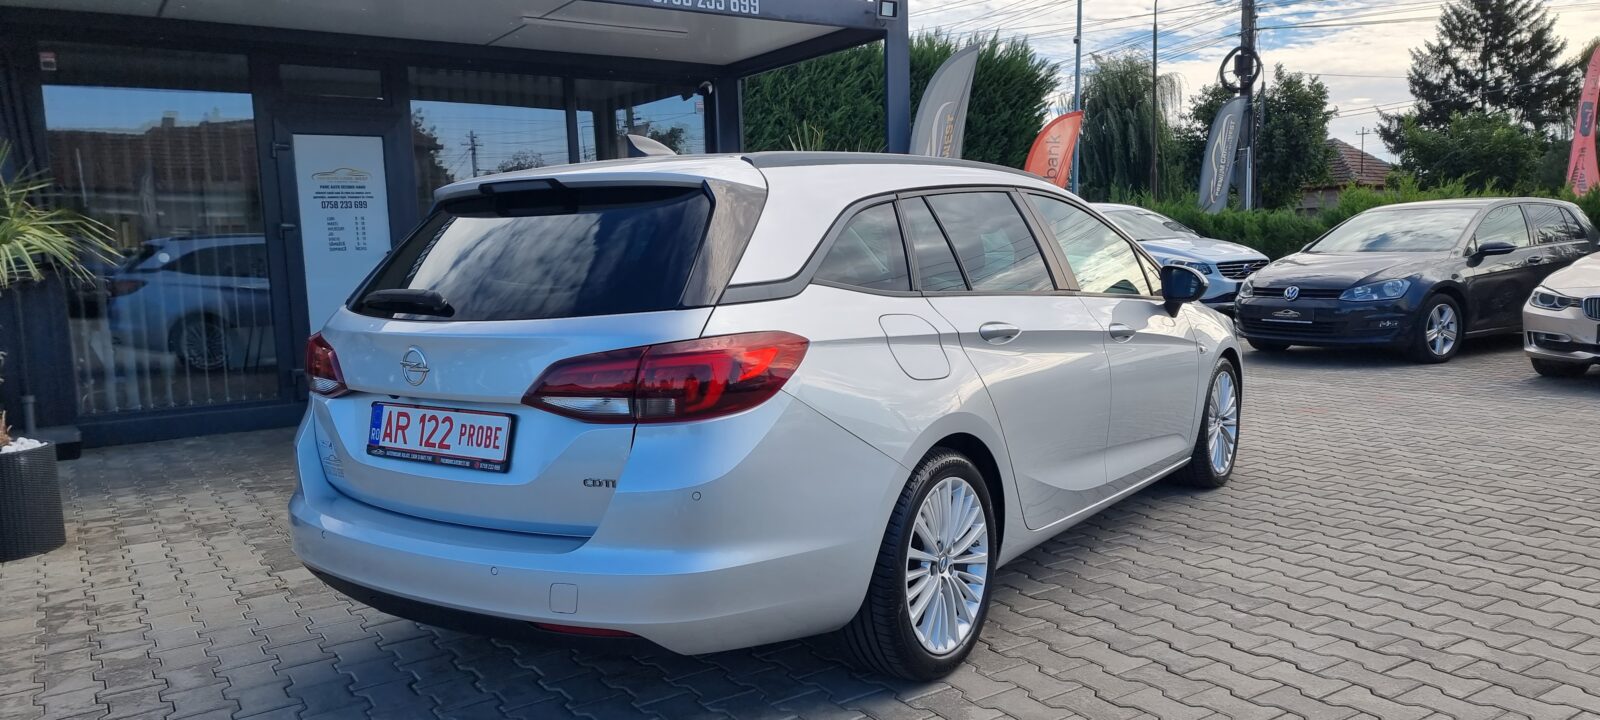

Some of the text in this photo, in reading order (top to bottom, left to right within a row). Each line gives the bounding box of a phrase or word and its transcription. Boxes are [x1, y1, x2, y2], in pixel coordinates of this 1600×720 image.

[730, 0, 760, 14] 699
[1042, 135, 1062, 179] bank
[1215, 165, 1226, 196] PREMIUM
[321, 200, 338, 209] 0758
[340, 200, 352, 209] 233
[371, 410, 503, 450] RO AR 122 PROBE
